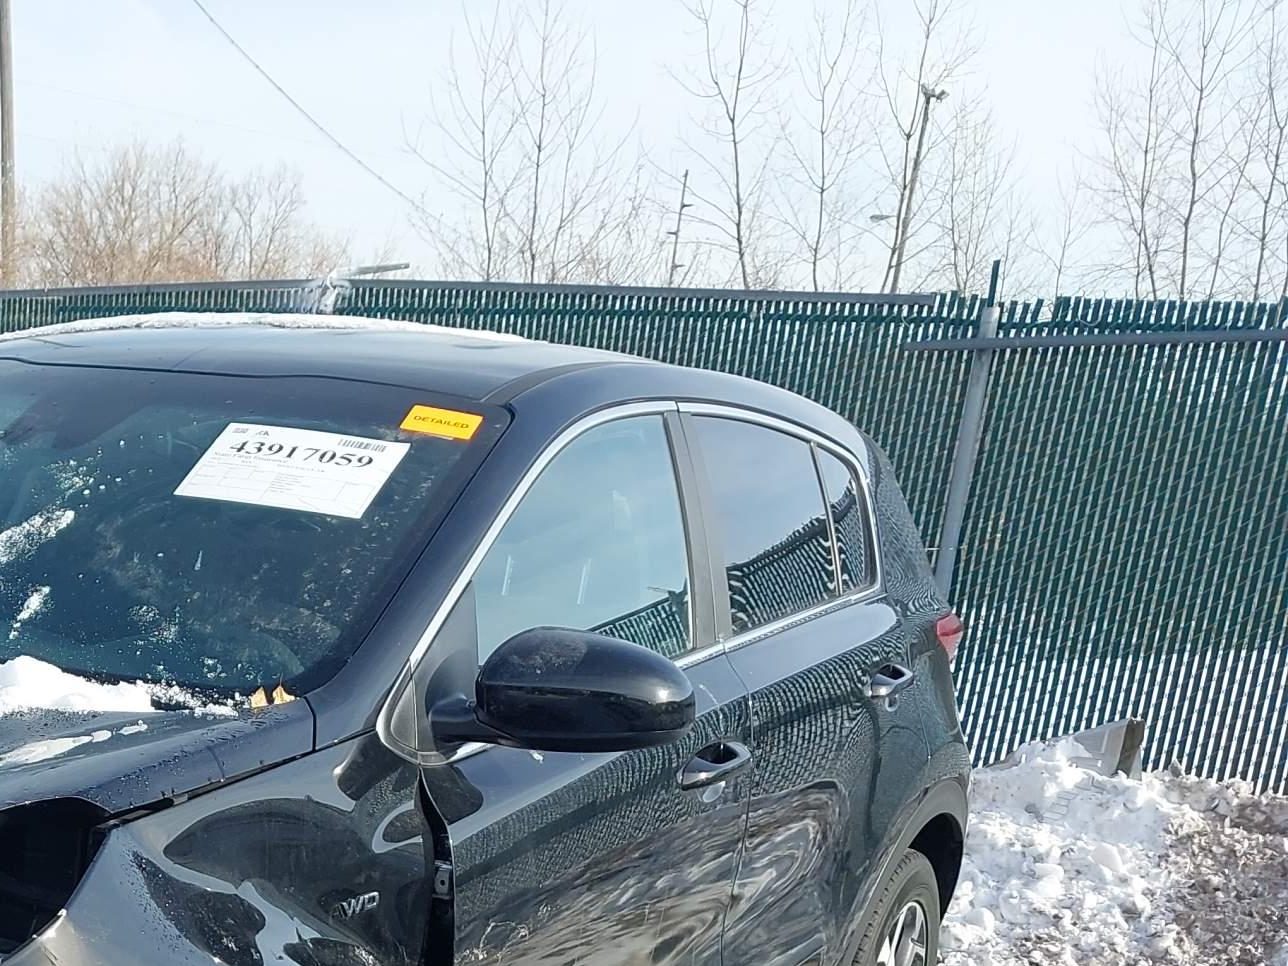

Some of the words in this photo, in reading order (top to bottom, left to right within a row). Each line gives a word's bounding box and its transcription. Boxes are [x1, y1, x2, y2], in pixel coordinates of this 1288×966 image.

[413, 414, 470, 429] DETAILED
[229, 439, 374, 468] 43917059
[329, 891, 380, 921] AWD
